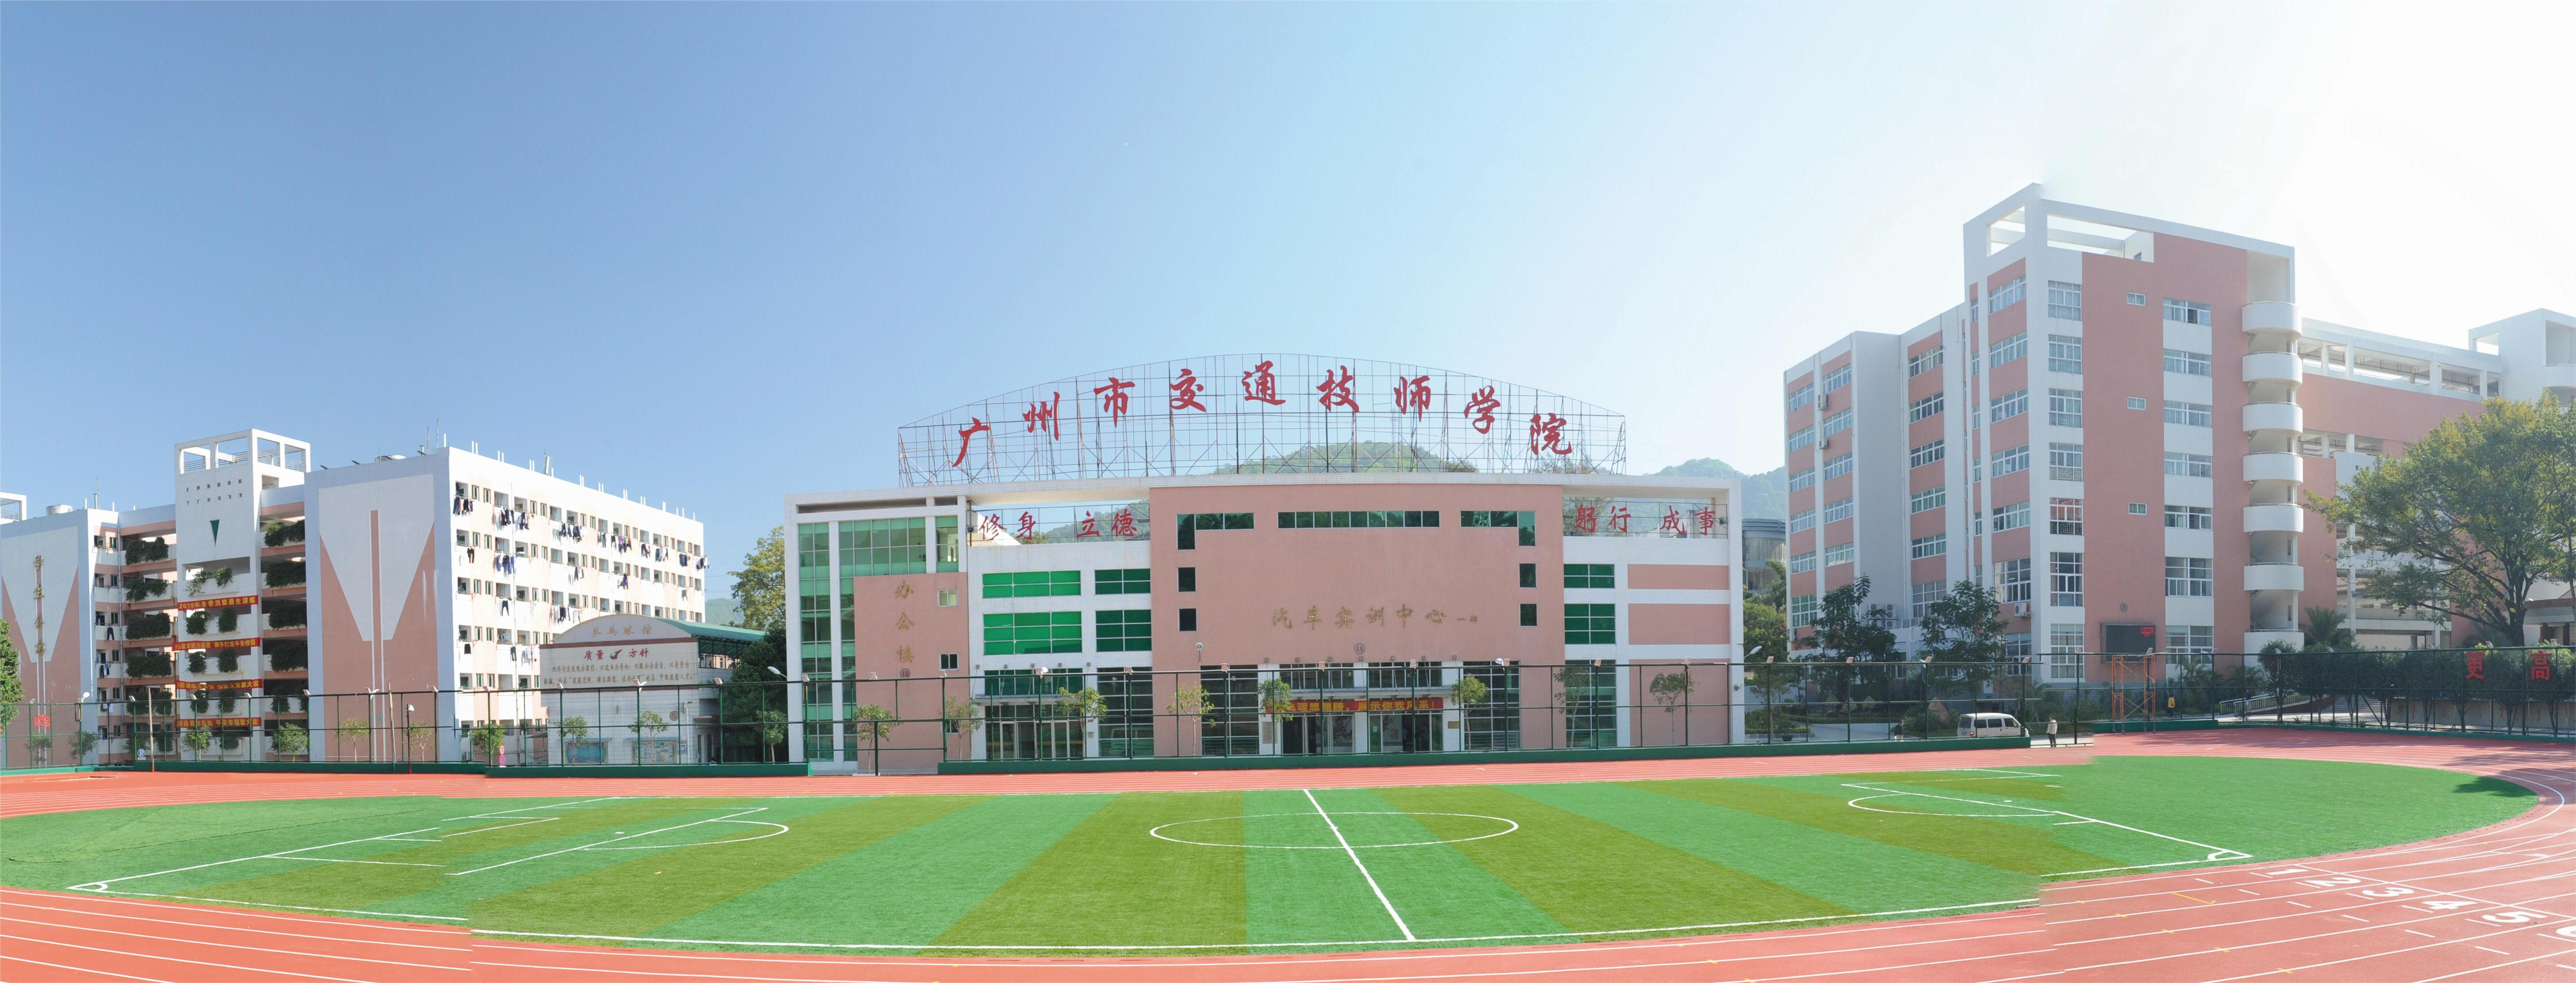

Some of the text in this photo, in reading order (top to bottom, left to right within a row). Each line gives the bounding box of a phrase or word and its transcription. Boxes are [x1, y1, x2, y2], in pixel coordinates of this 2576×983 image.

[952, 360, 1572, 467] 广州市交通技师学院
[978, 508, 1137, 541] 修身 立德
[1575, 504, 1716, 536] 躬行 成事
[33, 555, 45, 655] 学生公寓
[895, 580, 914, 663] 办公楼
[1273, 604, 1447, 630] 汽车实训中心
[590, 624, 652, 637] 乒乓球馆
[583, 648, 649, 661] 质量 方针
[2305, 877, 2361, 887] 2
[2362, 887, 2414, 897] 3
[2422, 900, 2478, 910] 4
[2482, 911, 2548, 923] 5
